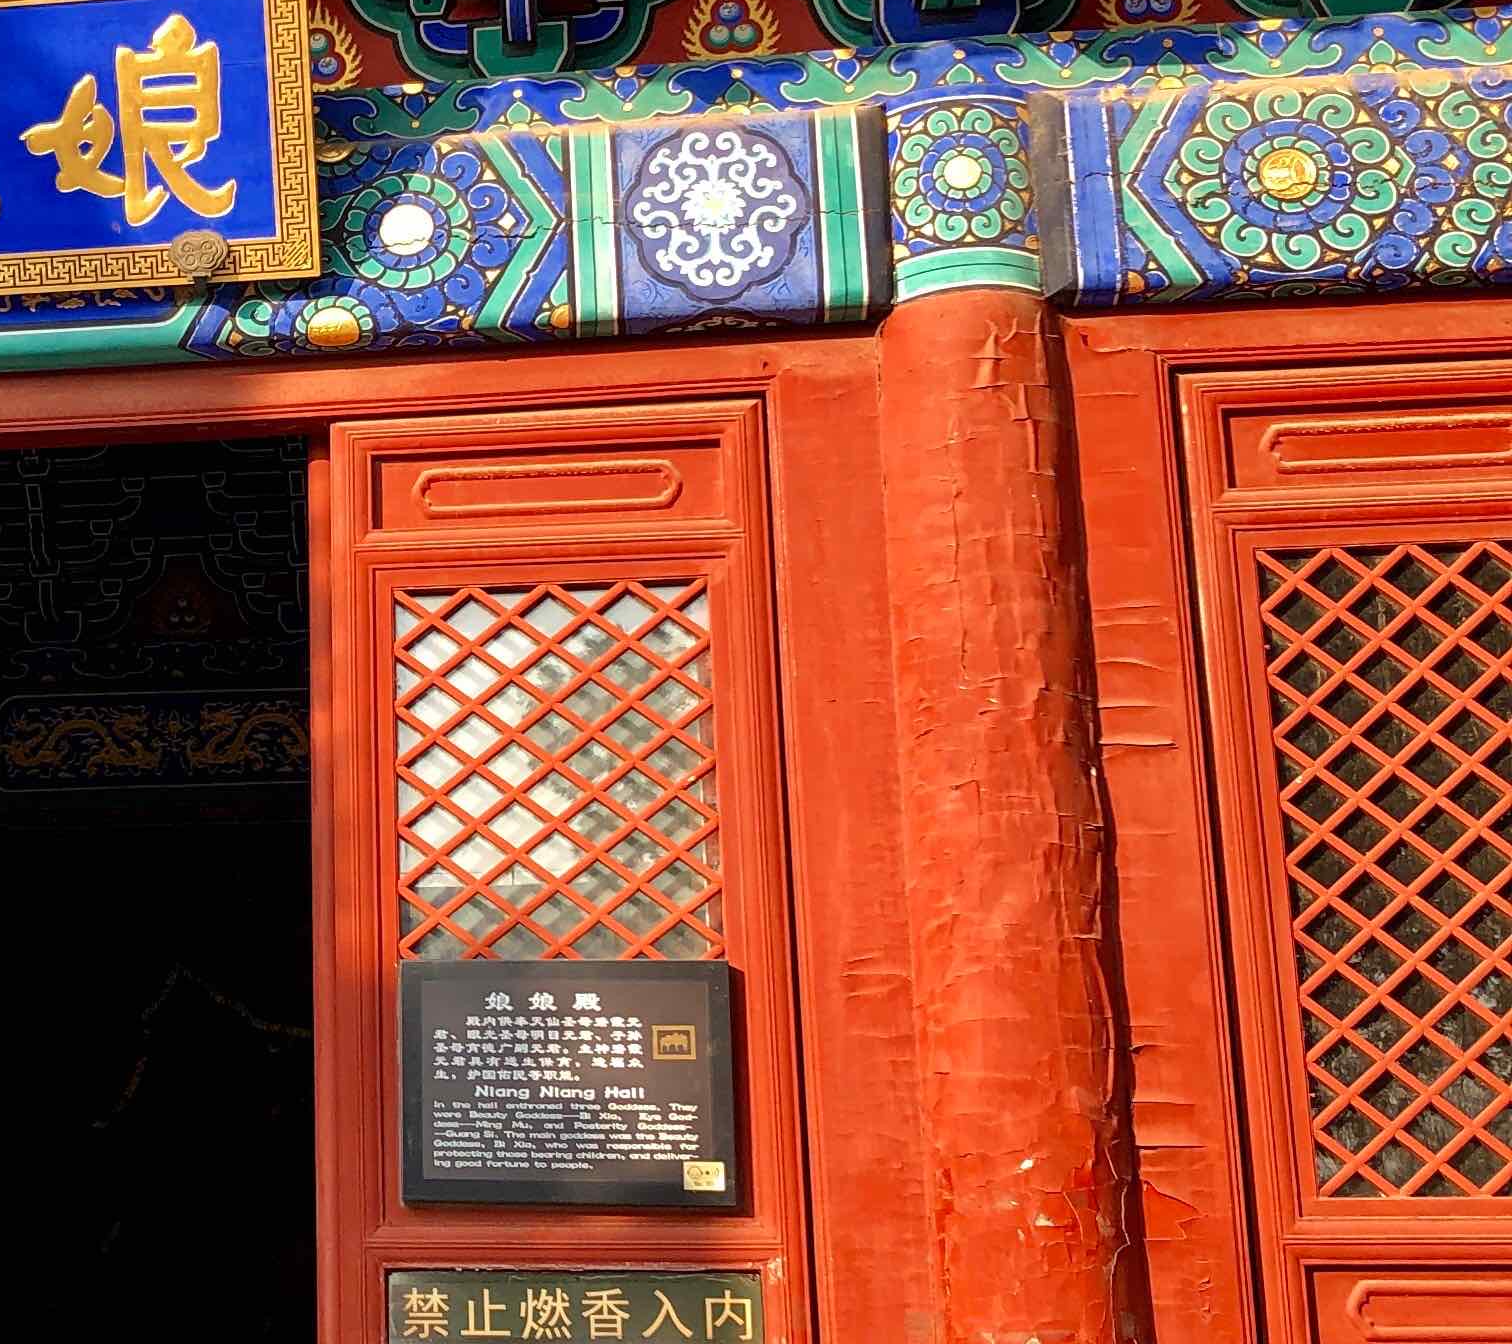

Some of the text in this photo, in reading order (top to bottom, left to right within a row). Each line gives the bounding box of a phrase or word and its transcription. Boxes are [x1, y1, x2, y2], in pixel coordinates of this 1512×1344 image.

[484, 992, 602, 1012] 娘娘殿
[474, 1085, 645, 1100] Niang Niang Hall
[433, 1100, 445, 1109] In
[452, 1101, 471, 1109] the
[505, 1102, 563, 1110] enthroned
[668, 1102, 698, 1112] They
[543, 1122, 564, 1130] and
[433, 1159, 451, 1168] ing
[454, 1159, 482, 1168] good
[487, 1160, 530, 1168] fortune
[402, 1287, 754, 1341] 禁止燃香入内
